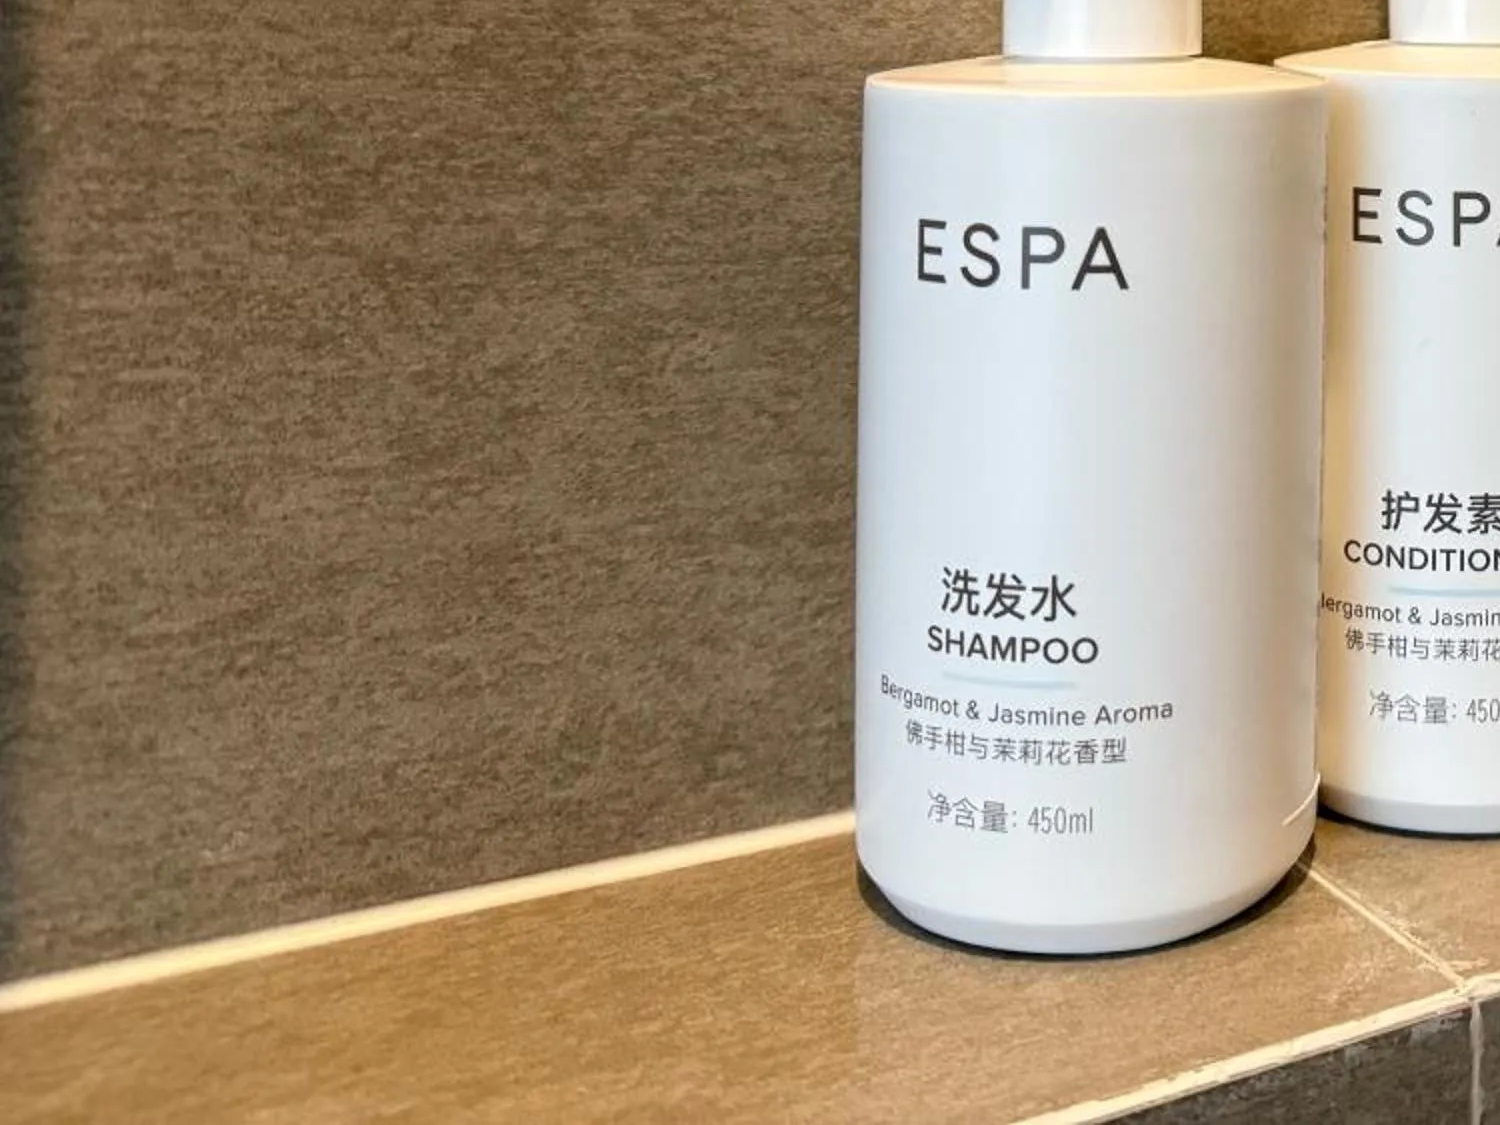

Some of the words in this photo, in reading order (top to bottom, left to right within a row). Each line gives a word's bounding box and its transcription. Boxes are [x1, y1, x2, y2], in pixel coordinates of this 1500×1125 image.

[917, 218, 1130, 292] ESPA
[940, 566, 1078, 622] 洗发水
[1407, 609, 1422, 625] &
[927, 624, 1100, 664] SHAMPOO
[880, 674, 959, 718] Bergamot
[965, 701, 980, 720] &
[988, 702, 1086, 726] Jasmine
[1094, 702, 1174, 726] Aroma
[905, 719, 1128, 765] 佛手柑与茉莉花香型
[1027, 806, 1095, 834] 450ml
